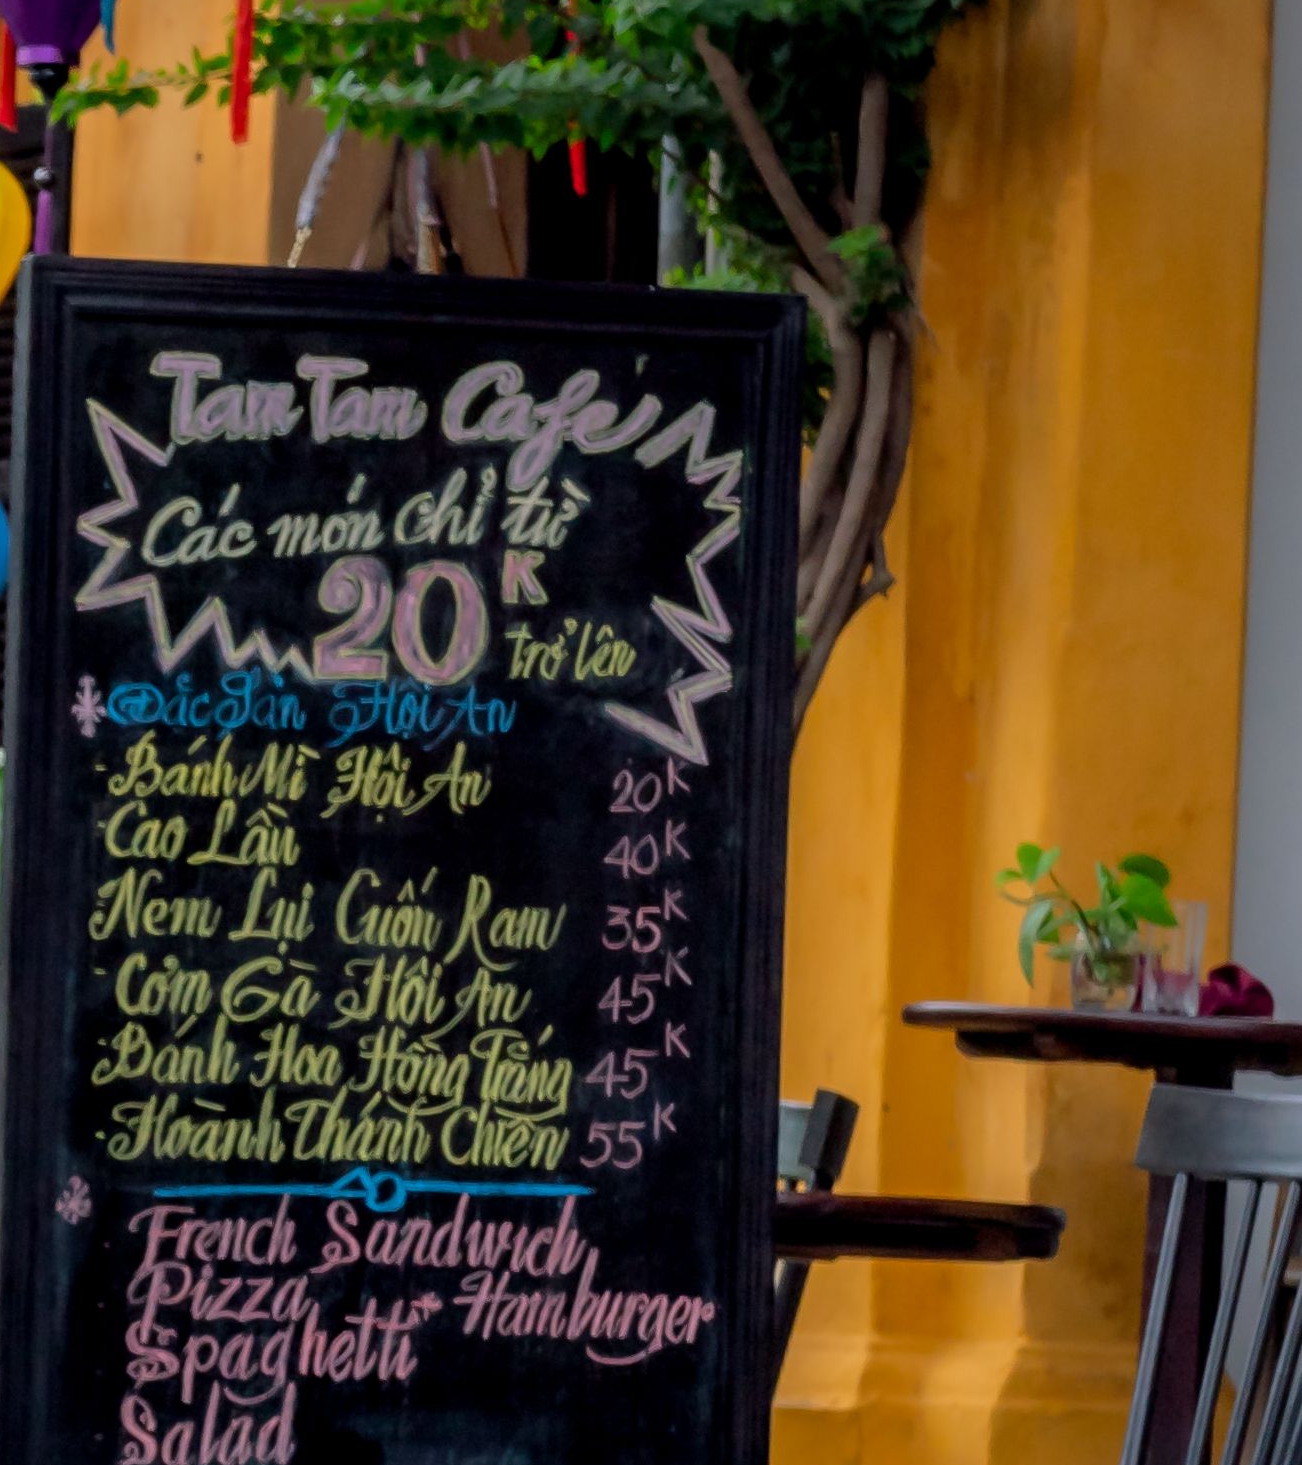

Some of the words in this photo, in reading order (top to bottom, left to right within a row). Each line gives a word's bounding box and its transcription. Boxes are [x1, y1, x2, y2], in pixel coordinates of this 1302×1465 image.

[149, 351, 303, 445] Tam
[296, 353, 428, 444] Tam
[142, 482, 257, 567] Các
[266, 472, 386, 558] món
[575, 621, 637, 680] lên
[422, 684, 517, 751] An
[108, 729, 238, 796] Bánh
[320, 742, 416, 823] Hội
[402, 741, 493, 816] An
[105, 799, 189, 862] Cao
[186, 799, 301, 866] Lầu
[89, 867, 223, 941] Nem
[335, 866, 443, 952] Cuốn
[443, 873, 567, 973] Ram
[220, 956, 321, 1022] Gà
[421, 967, 533, 1044] An
[91, 1013, 240, 1086] Bánh
[347, 1024, 471, 1116] Hồng
[107, 1085, 286, 1162] Hoành
[284, 1085, 432, 1164] Thánh
[128, 1192, 297, 1271] French
[309, 1192, 587, 1277] Sandwich
[125, 1297, 425, 1405] Spaghetti
[453, 1247, 716, 1366] Hamburger
[126, 1260, 315, 1344] Pizza
